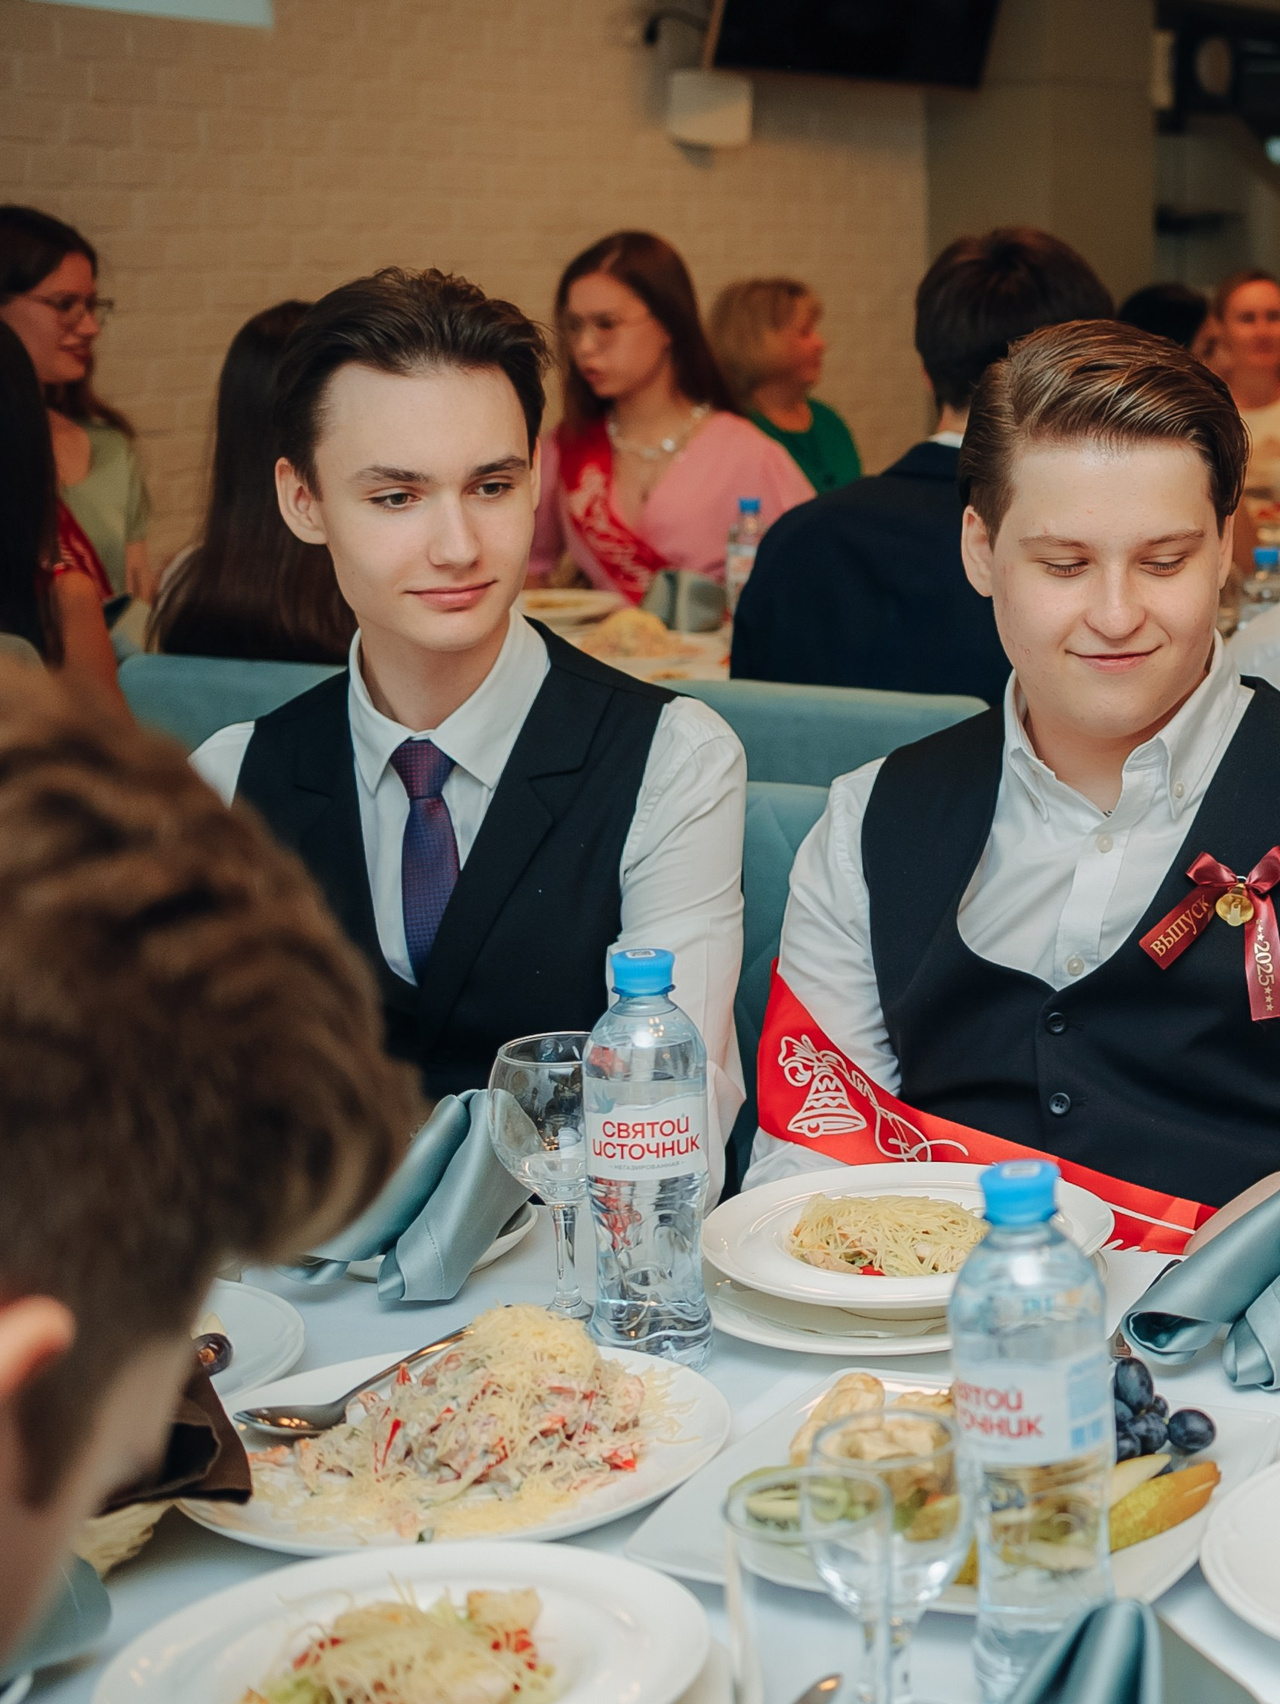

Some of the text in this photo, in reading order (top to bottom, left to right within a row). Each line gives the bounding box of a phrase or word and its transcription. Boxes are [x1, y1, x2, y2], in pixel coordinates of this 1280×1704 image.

[1150, 894, 1210, 957] ВЫПУСК
[1253, 941, 1275, 985] 2025
[602, 1114, 690, 1139] СВЯТОЙ
[592, 1133, 700, 1160] ИСТОЧНИК
